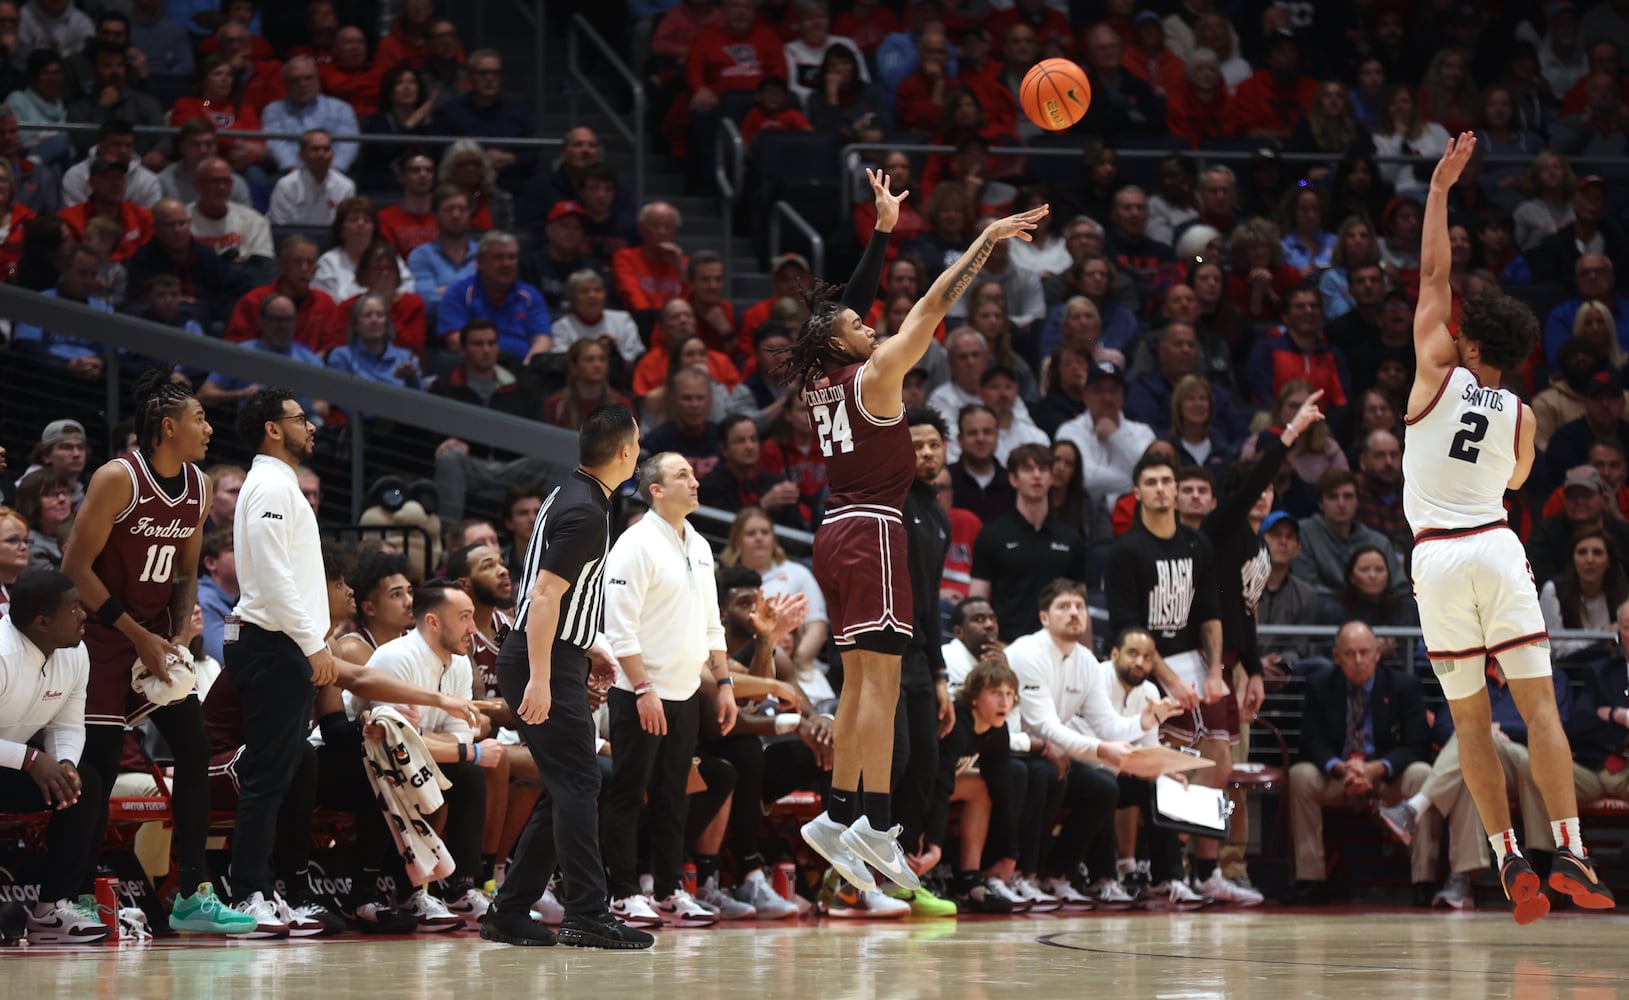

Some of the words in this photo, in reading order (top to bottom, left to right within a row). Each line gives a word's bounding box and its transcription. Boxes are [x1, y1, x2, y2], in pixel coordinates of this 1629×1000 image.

[806, 384, 845, 406] CHARLTON
[1461, 383, 1504, 412] SANTOS
[813, 400, 854, 457] 24
[1448, 411, 1489, 464] 2
[261, 511, 283, 520] A10
[139, 544, 176, 583] 10
